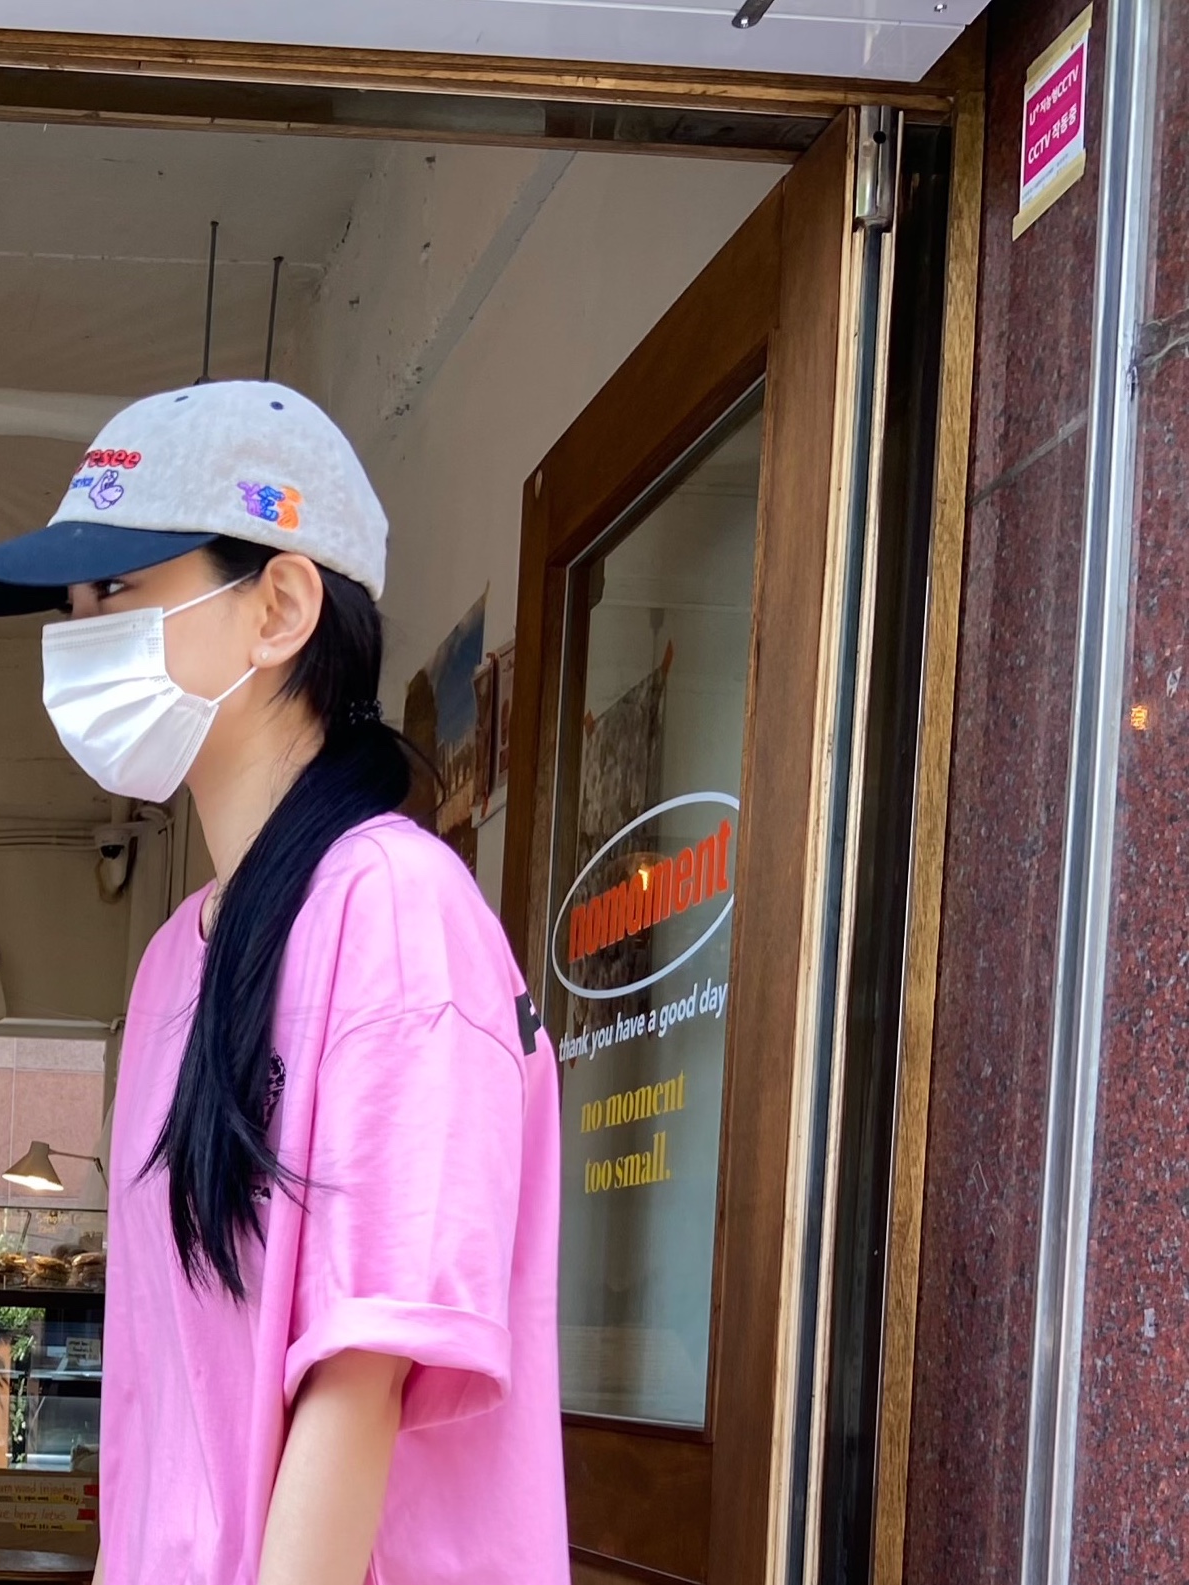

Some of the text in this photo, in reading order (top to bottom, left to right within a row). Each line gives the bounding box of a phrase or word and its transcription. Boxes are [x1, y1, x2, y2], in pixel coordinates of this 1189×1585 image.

[1027, 129, 1052, 165] CCTV
[558, 976, 729, 1064] thank you have a good day
[580, 1069, 686, 1134] no moment
[584, 1130, 671, 1195] too small.
